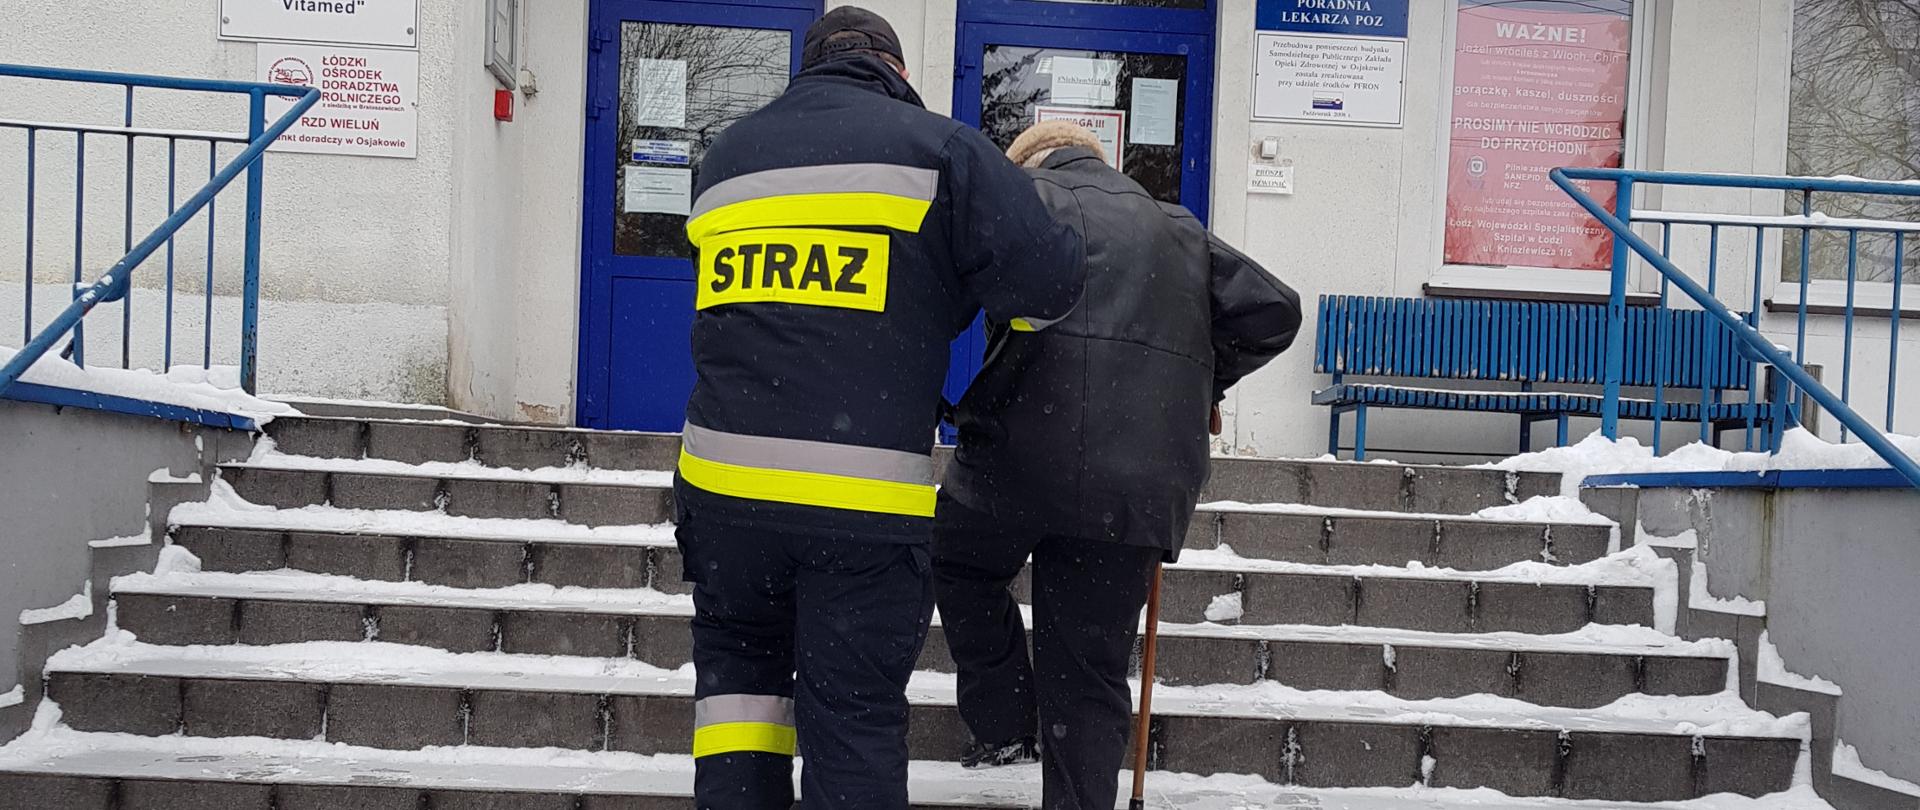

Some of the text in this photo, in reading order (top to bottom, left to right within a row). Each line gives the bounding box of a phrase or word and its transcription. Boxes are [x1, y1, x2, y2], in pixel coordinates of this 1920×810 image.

[1297, 0, 1371, 11] PORADNIA
[1281, 11, 1384, 27] LEKARZA POZ
[1496, 22, 1587, 43] WAŻNE!
[1272, 41, 1313, 50] Przebudowa
[1360, 45, 1390, 54] budynku
[322, 54, 367, 67] ŁÓDZKI
[1268, 50, 1319, 60] Samodzielnego
[1322, 53, 1363, 62] Publicznego
[1543, 51, 1550, 59] z
[1274, 60, 1297, 69] Opieki
[1299, 61, 1339, 70] Zdrowotnej
[1350, 63, 1385, 72] Osjakowie
[322, 67, 382, 80] OŚRODEK
[1321, 72, 1364, 80] zrealizowana
[322, 80, 399, 93] DORADZTWA
[1278, 80, 1293, 88] przy
[322, 92, 401, 105] ROLNICZEGO
[1454, 85, 1512, 98] gorączkę,
[1558, 91, 1618, 105] duszności
[302, 117, 380, 130] RZD WIELUŃ
[1454, 117, 1611, 140] PROSIMY NIE WCHODZIĆ
[299, 134, 343, 145] doradczy
[356, 136, 406, 147] Osjakowie
[1481, 136, 1587, 155] DO PRZYCHODNI
[1494, 232, 1526, 243] Szpital
